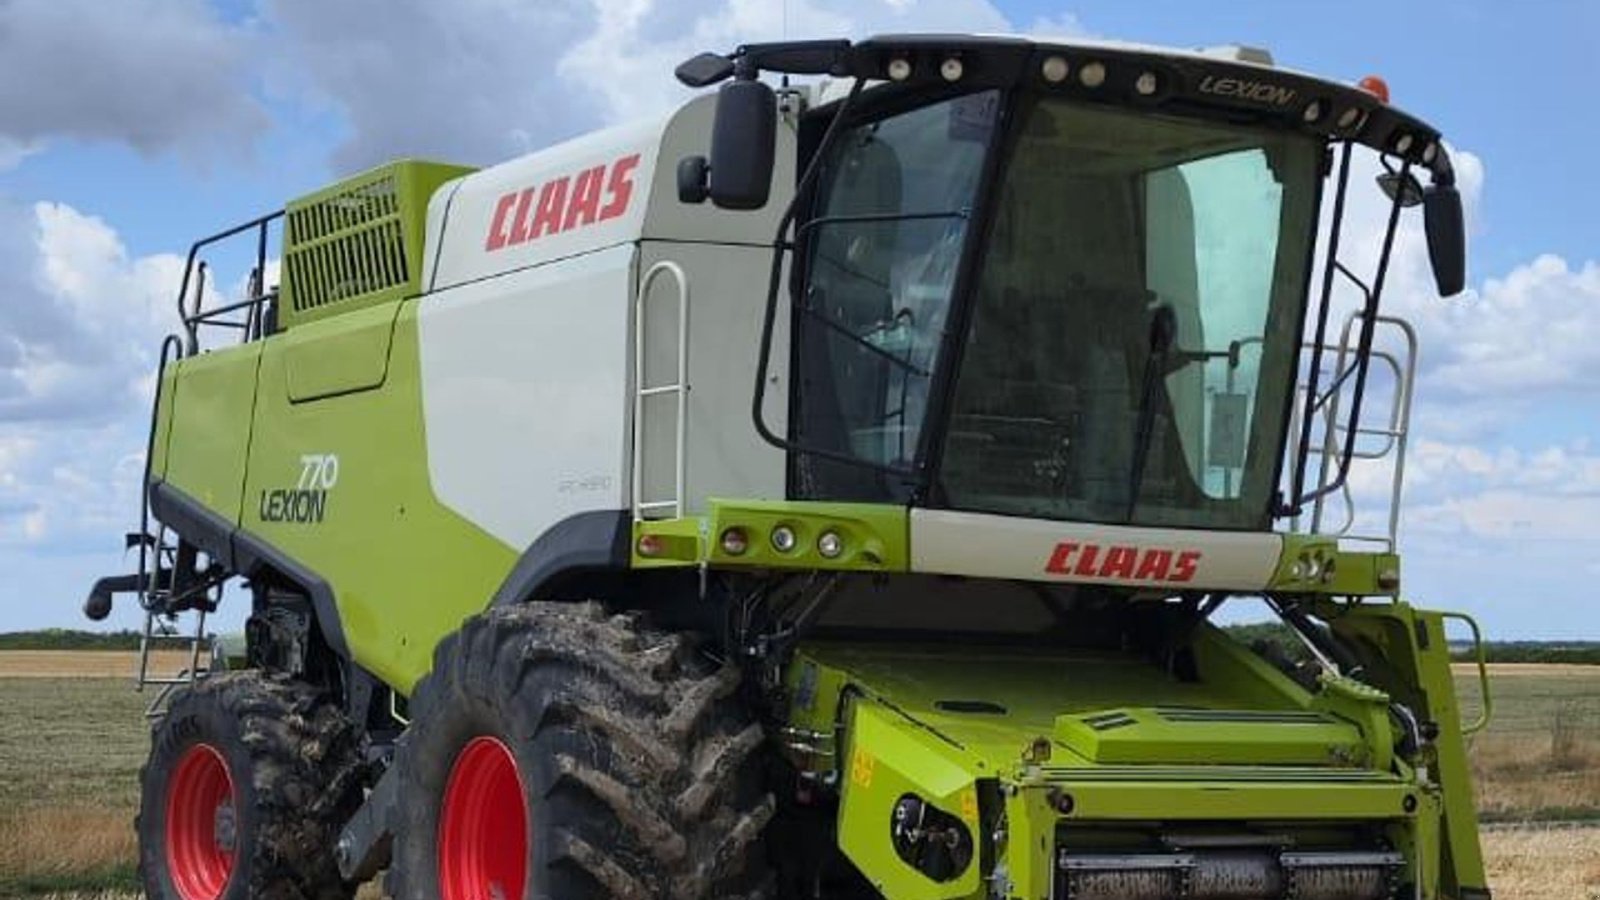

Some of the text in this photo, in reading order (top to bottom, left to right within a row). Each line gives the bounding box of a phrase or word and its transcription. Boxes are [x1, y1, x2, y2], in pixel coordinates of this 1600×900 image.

[1199, 76, 1296, 106] LEXION
[485, 154, 641, 251] CLAAS
[298, 453, 338, 489] 770
[260, 489, 326, 523] LEXION
[1045, 543, 1202, 581] CLAAS
